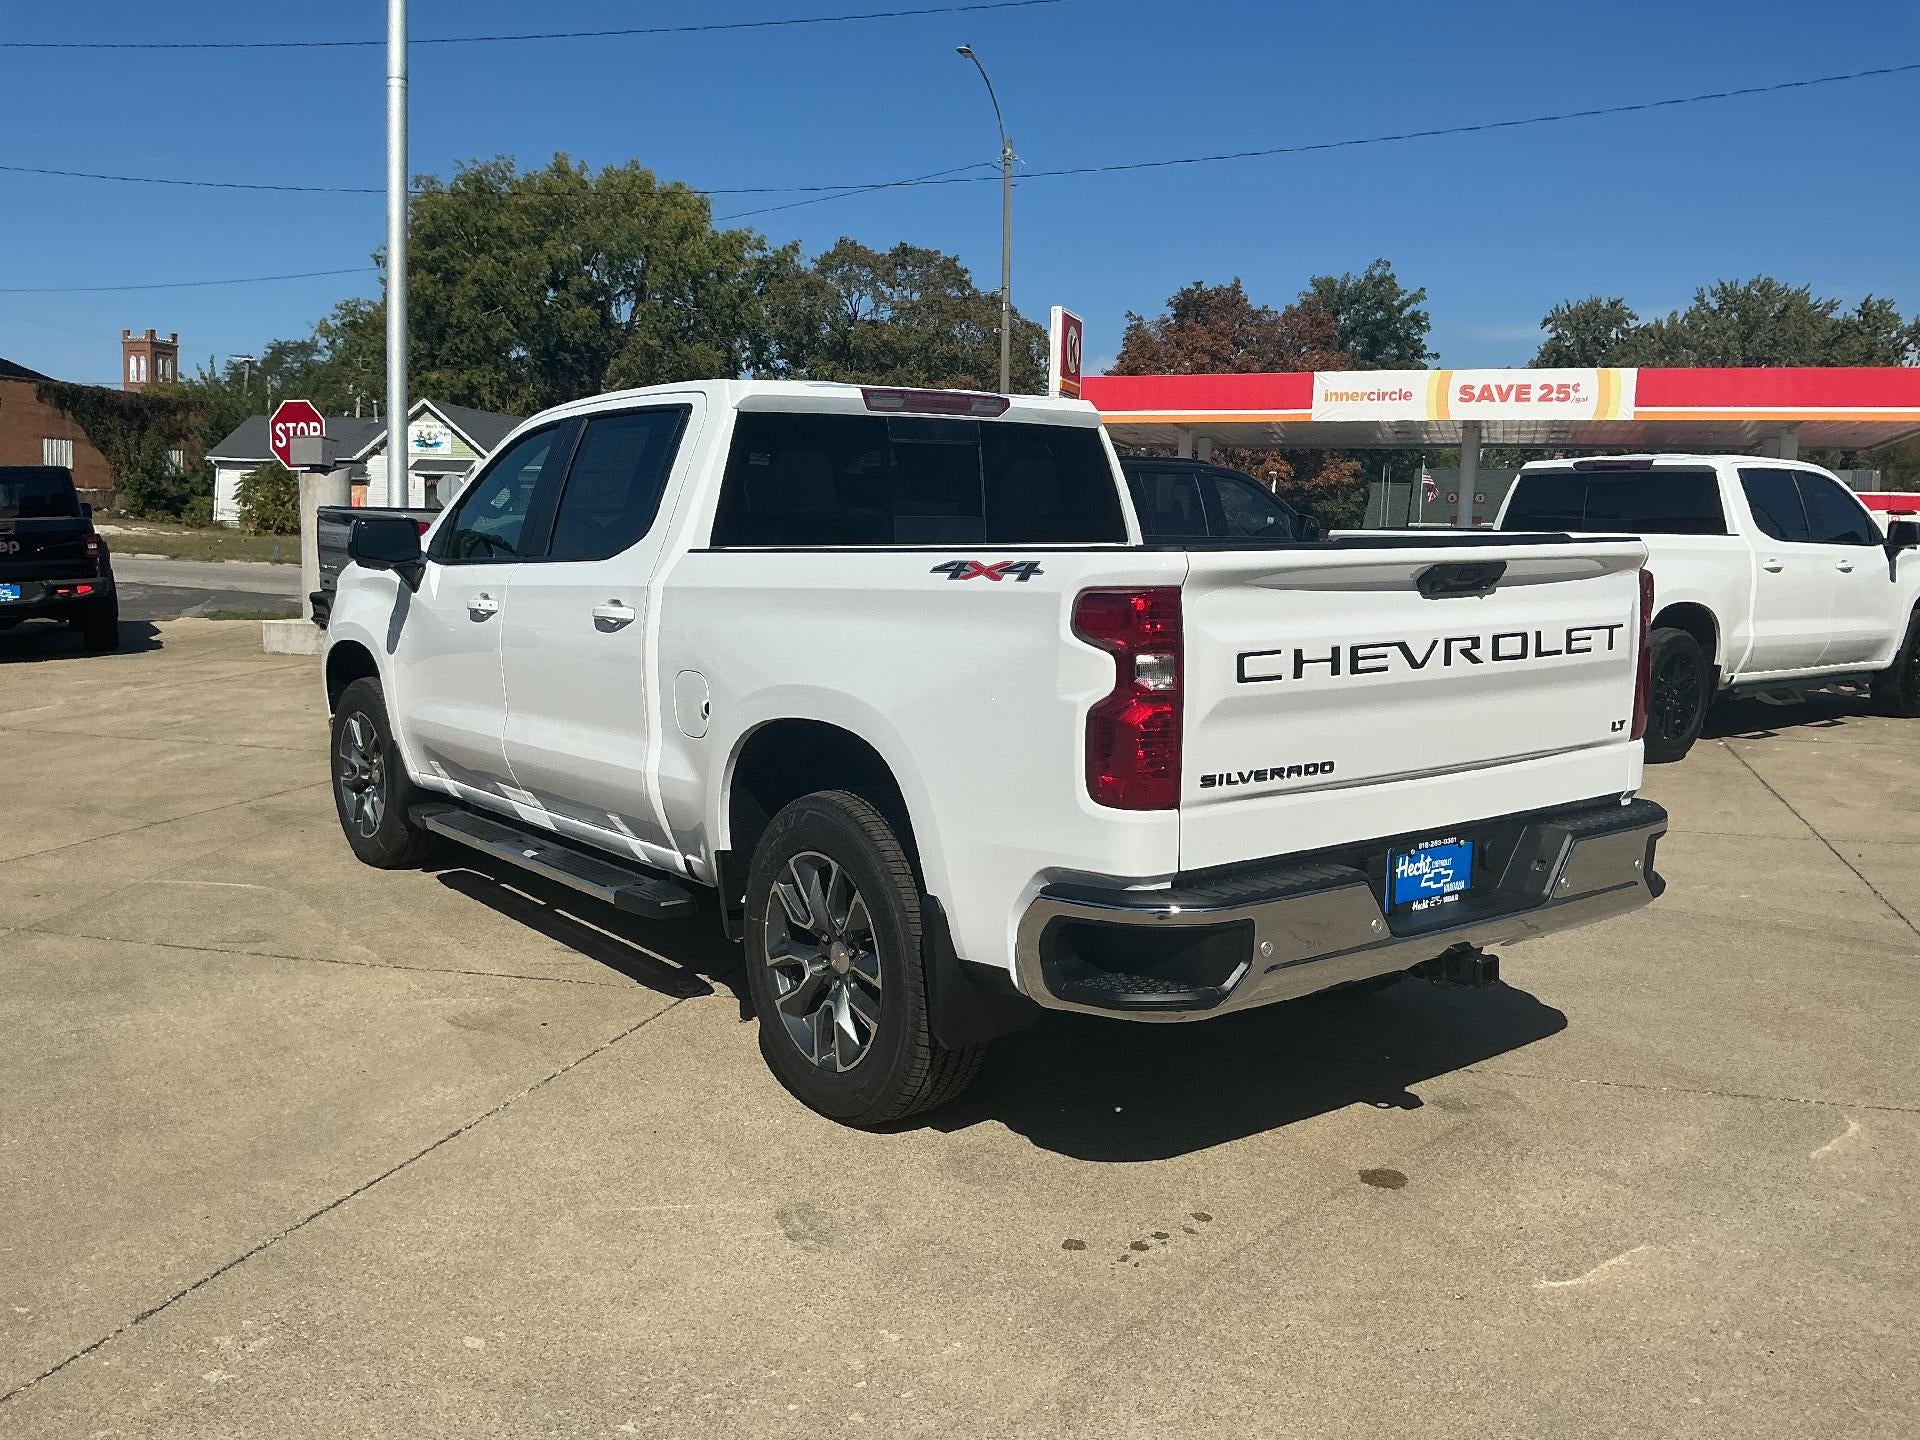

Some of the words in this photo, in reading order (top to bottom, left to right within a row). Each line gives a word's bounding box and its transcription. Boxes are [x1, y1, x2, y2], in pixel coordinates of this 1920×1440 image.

[1324, 388, 1413, 402] innercircle
[1458, 384, 1532, 403] SAVE
[275, 422, 321, 448] STOP
[0, 541, 20, 555] ep
[1236, 623, 1624, 684] CHEVROLET
[1611, 719, 1627, 733] LT
[1200, 761, 1335, 789] SILVERADO
[1396, 854, 1432, 879] Hecht
